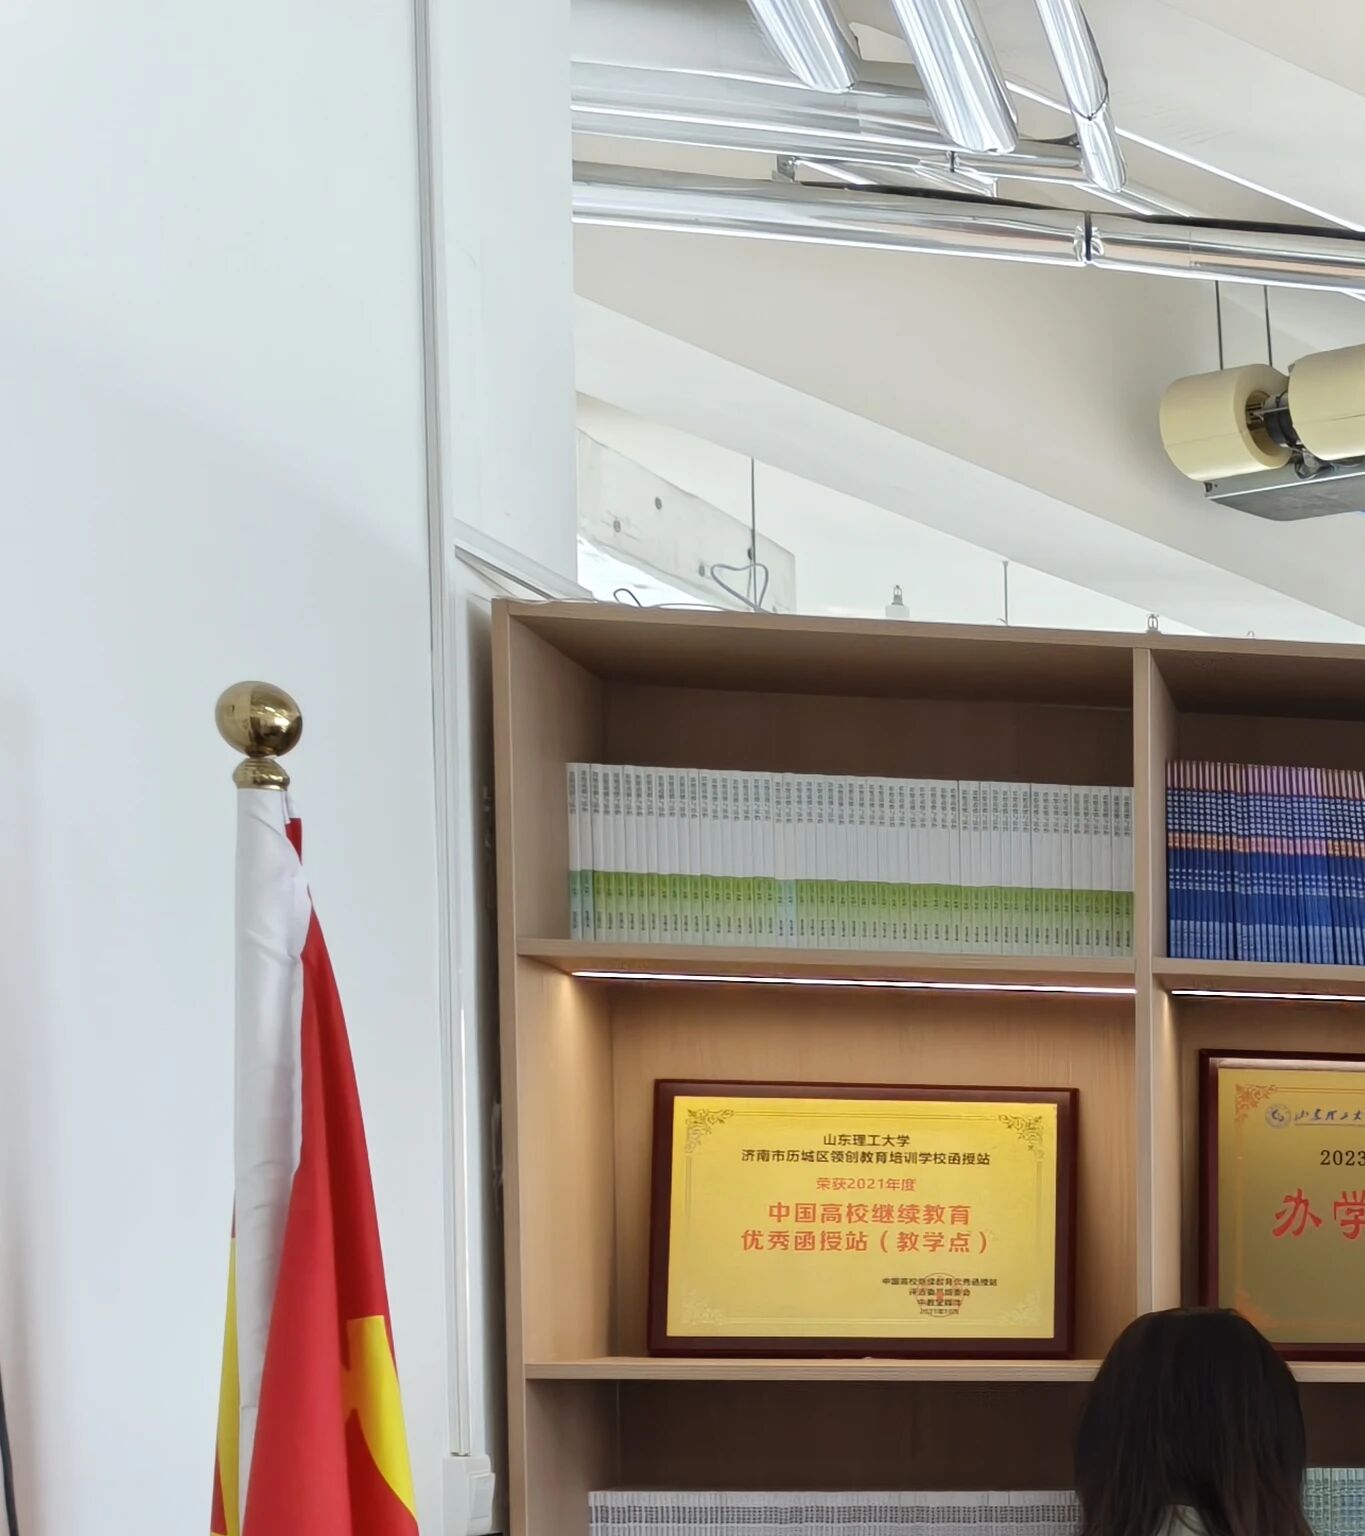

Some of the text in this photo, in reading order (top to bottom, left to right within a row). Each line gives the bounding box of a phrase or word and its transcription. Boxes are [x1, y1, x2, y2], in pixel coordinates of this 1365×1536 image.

[823, 1133, 910, 1148] 山东理工大学
[741, 1149, 990, 1166] 济南市历城区领创教育培训学校函授站
[816, 1177, 916, 1192] 荣获2021年度
[768, 1202, 972, 1225] 中国高校继续教育
